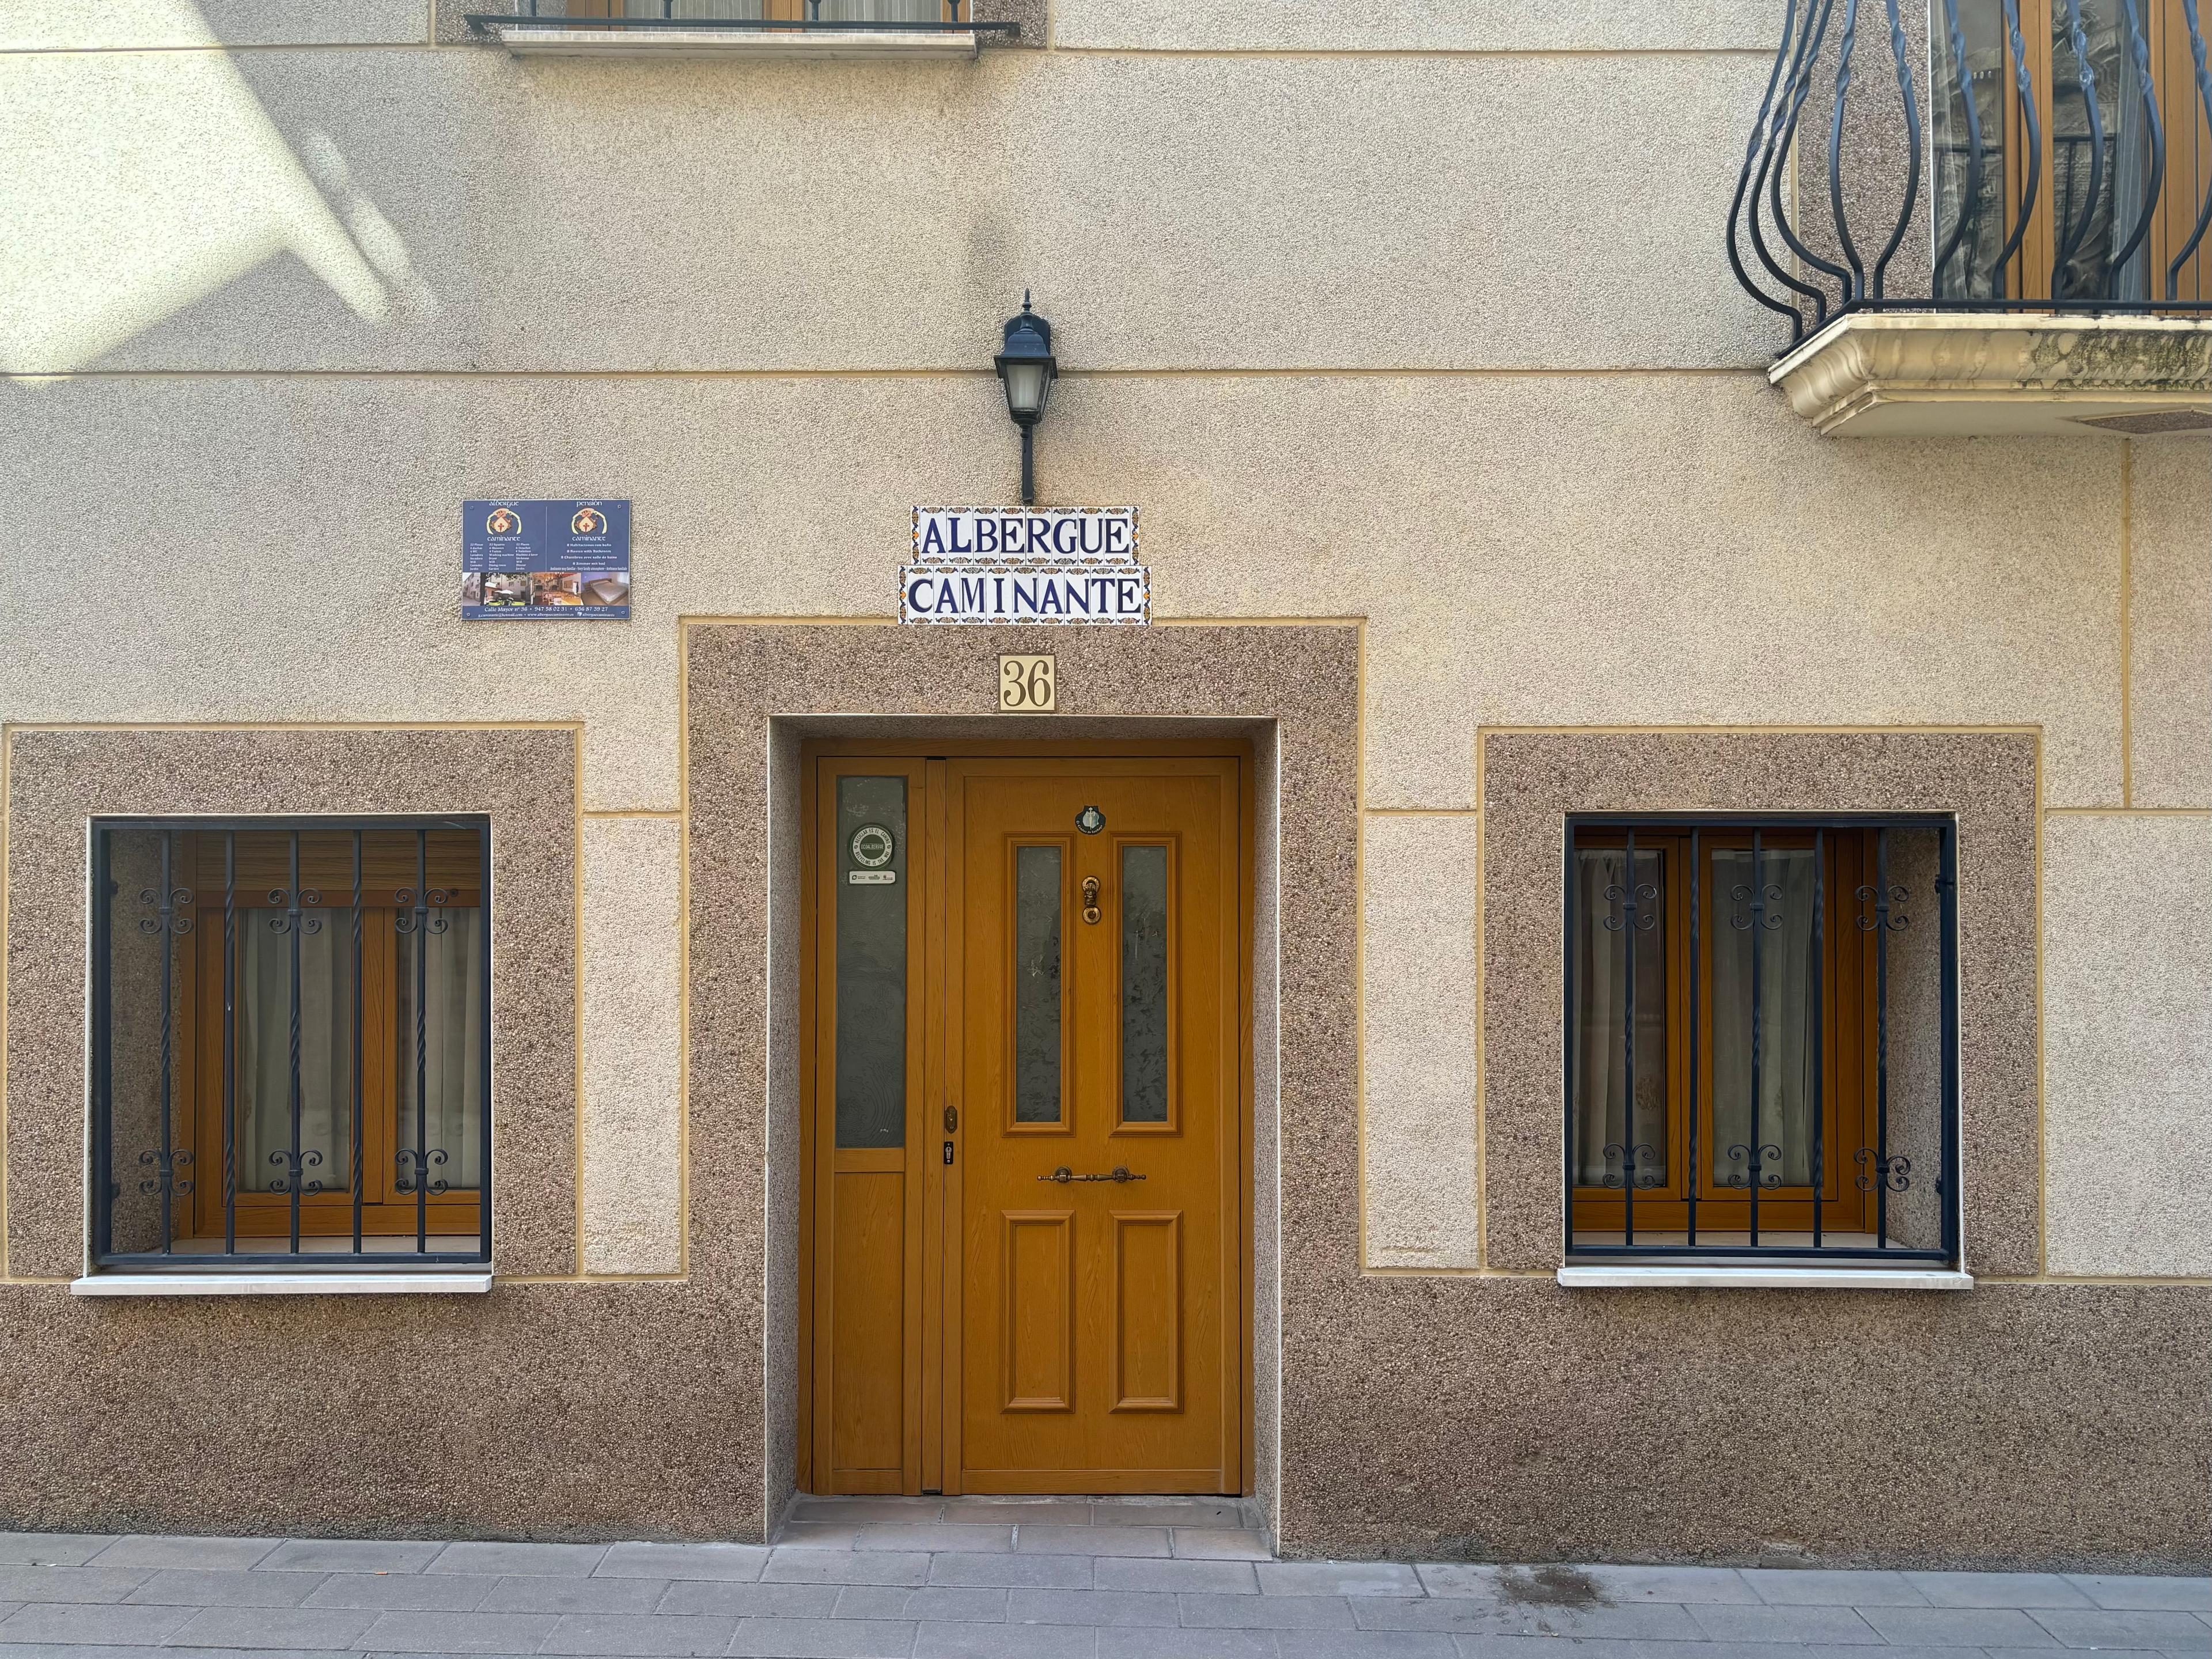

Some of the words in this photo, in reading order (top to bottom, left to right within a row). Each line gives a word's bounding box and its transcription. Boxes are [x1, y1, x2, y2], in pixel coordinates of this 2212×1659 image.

[488, 499, 520, 507] albergue
[921, 517, 1130, 555] ALBERGUE
[908, 577, 1142, 615] CAMINANTE
[1003, 660, 1051, 708] 36
[855, 830, 869, 844] RECICLAR
[880, 831, 891, 844] CAMINO
[855, 851, 871, 865] RECYCLING
